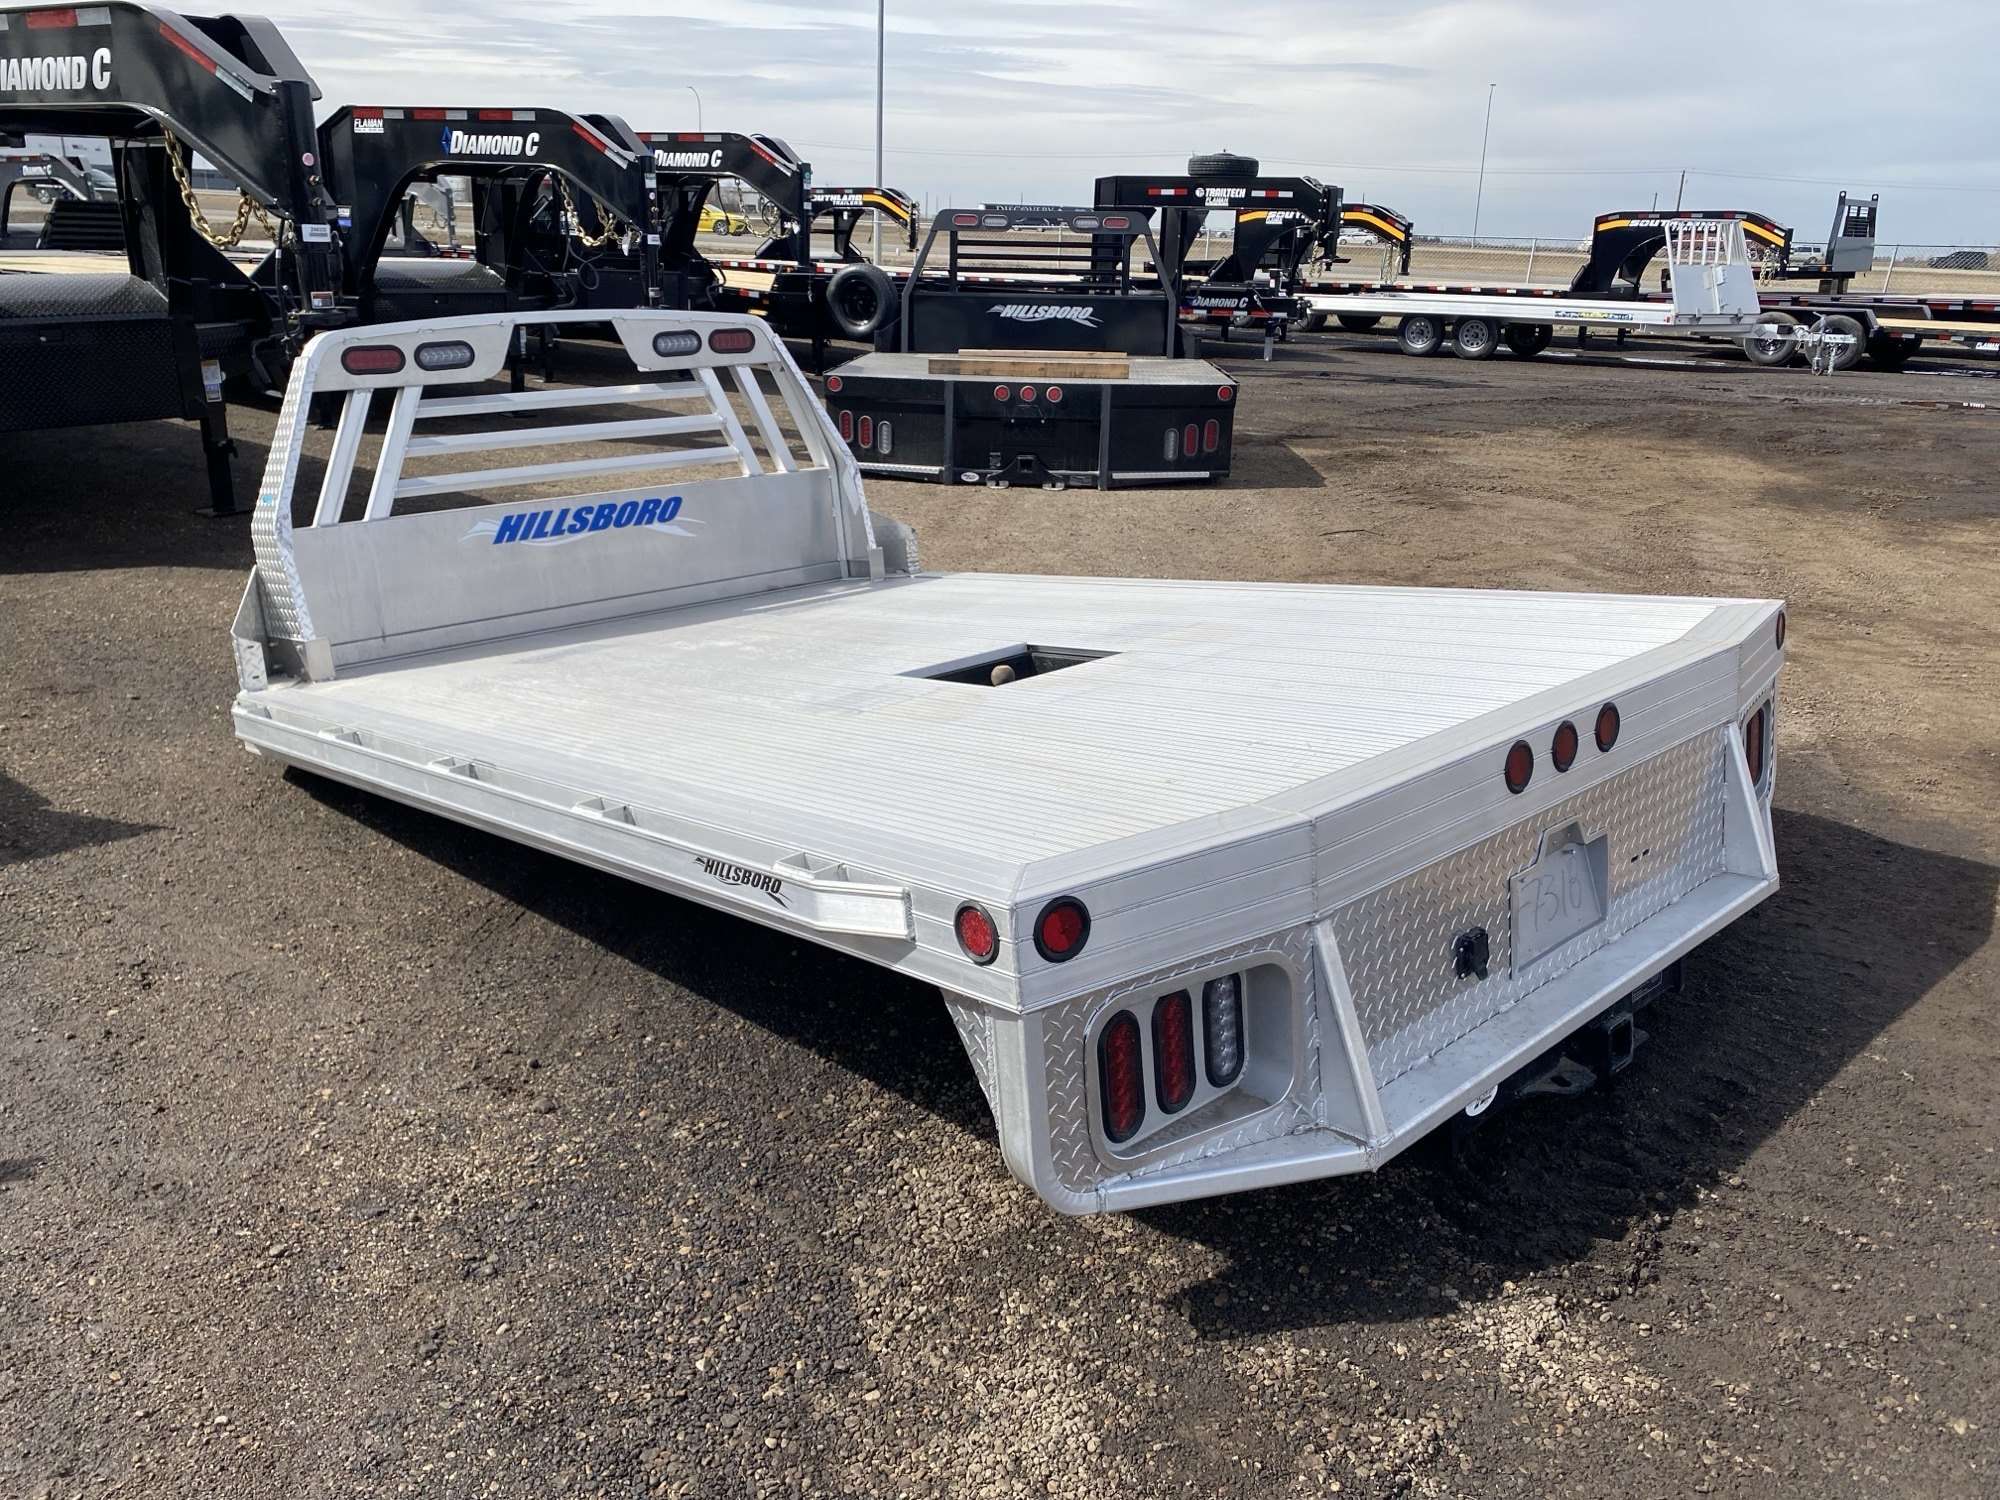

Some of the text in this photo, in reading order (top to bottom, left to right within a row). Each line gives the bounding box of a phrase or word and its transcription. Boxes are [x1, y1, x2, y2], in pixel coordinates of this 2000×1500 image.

[0, 47, 112, 91] IAMOND C
[449, 130, 540, 157] DIAMOND C
[710, 149, 723, 168] C
[809, 194, 864, 202] OUTHLAND
[1205, 187, 1246, 198] TRAILTECH
[1239, 296, 1249, 308] C
[1000, 304, 1094, 320] HILLSBORO
[493, 496, 683, 544] HILLSBORO
[703, 858, 782, 894] HILLSBORO
